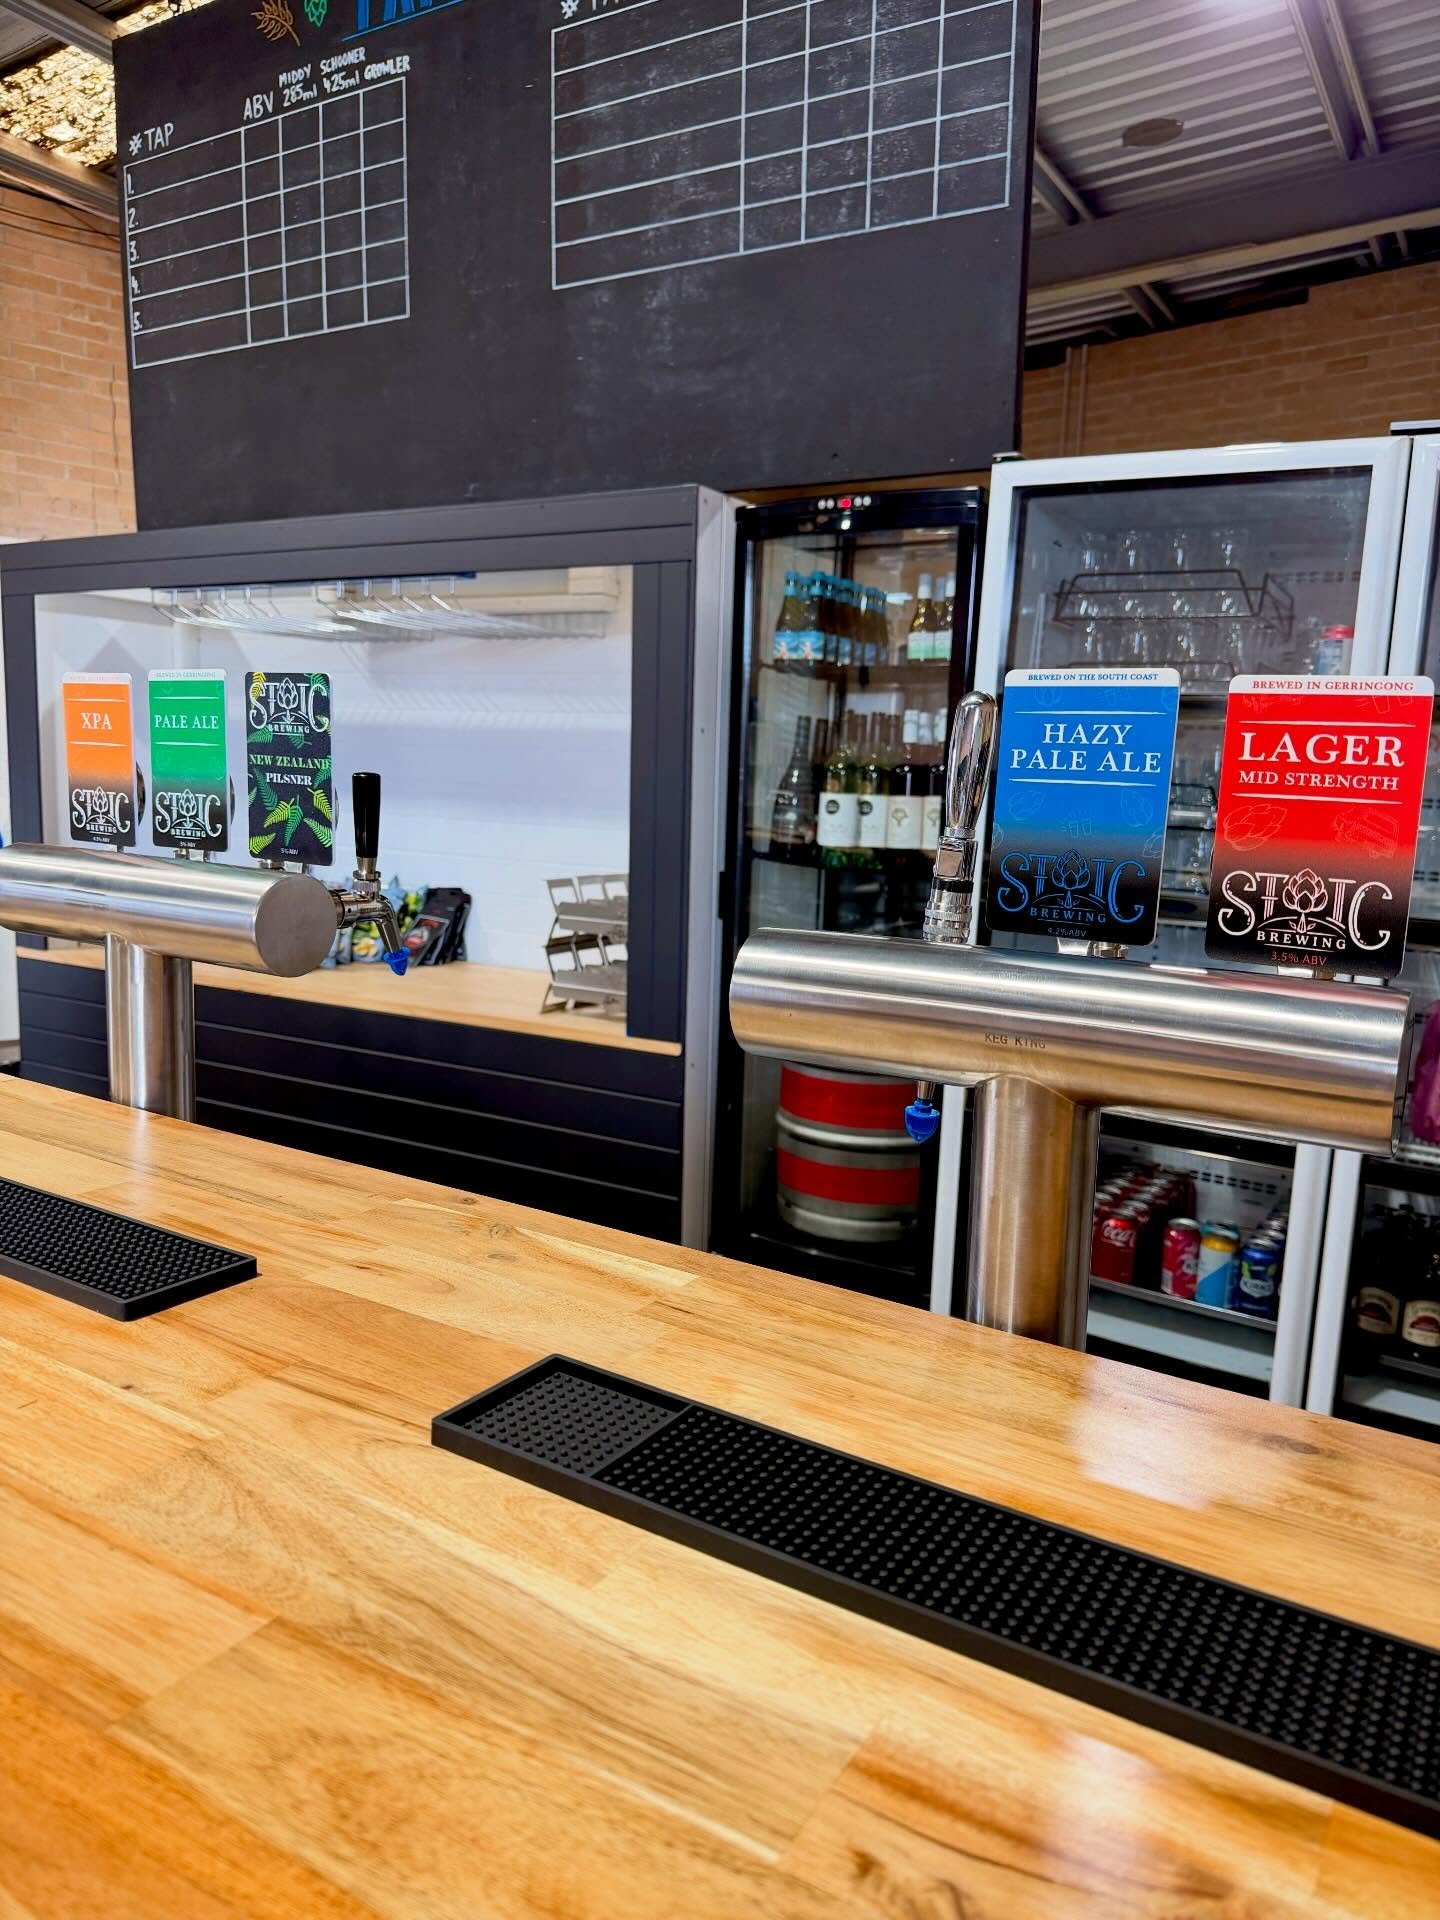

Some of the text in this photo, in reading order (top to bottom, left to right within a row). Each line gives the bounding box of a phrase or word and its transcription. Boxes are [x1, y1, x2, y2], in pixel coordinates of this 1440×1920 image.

[278, 46, 366, 88] MIDDY SCHOONER
[243, 55, 411, 121] ABV 285ml 425ml GROWLER
[1028, 673, 1159, 681] BREWED ON THE SOUTH COAST
[1252, 680, 1415, 691] BREWED IN GERRINGONG
[80, 712, 113, 730] XPA
[154, 714, 219, 729] PALE ALE
[268, 723, 311, 734] BREWING
[1042, 723, 1133, 745] HAZY
[1238, 732, 1405, 767] LAGER
[250, 753, 330, 769] NEW ZEALAND
[1010, 748, 1161, 773] PALE ALE
[266, 772, 313, 786] PILSNER
[1239, 770, 1399, 791] MID STRENGTH
[86, 823, 117, 834] BREWING
[170, 828, 207, 838] BREWING
[1030, 907, 1106, 924] BREWING
[1256, 930, 1346, 950] BREWING
[1271, 951, 1327, 966] 3.5% ABV
[984, 1032, 1046, 1049] KEG KING
